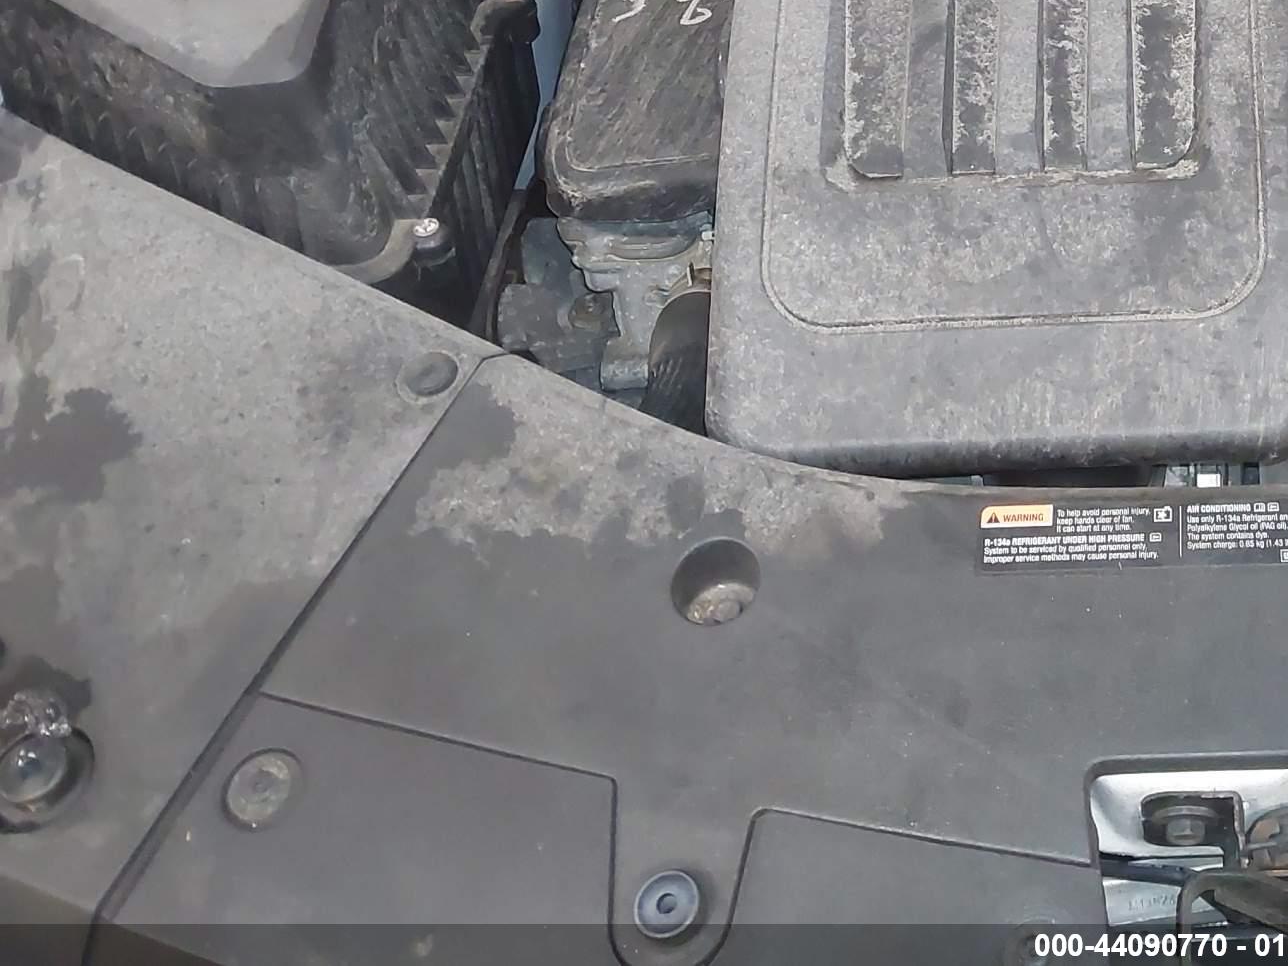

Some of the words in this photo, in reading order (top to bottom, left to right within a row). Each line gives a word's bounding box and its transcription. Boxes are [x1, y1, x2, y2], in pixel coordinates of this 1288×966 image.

[1067, 509, 1079, 518] help
[1081, 508, 1099, 516] avoid
[1102, 508, 1129, 517] personal
[1201, 504, 1251, 513] CONDITIONING
[1003, 514, 1044, 522] WARNING
[1057, 517, 1072, 526] keep
[1075, 516, 1094, 524] hands
[1122, 515, 1134, 523] fan.
[1201, 516, 1214, 524] only
[1242, 514, 1278, 523] Refrigerant
[1188, 524, 1227, 532] Polyalkylene
[1260, 523, 1275, 531] (PAG
[985, 538, 1010, 546] R-134a
[1012, 536, 1061, 545] REFRIGERANT
[1063, 536, 1087, 544] UNDER
[1089, 535, 1106, 543] HIGH
[1108, 534, 1144, 542] PRESSURE
[1201, 533, 1224, 541] system
[984, 547, 1009, 556] System
[1029, 545, 1057, 553] serviced
[1069, 544, 1096, 554] qualified
[1099, 543, 1130, 553] personnel
[1187, 542, 1211, 550] System
[1213, 541, 1238, 549] charge:
[1266, 540, 1283, 548] (1.43
[984, 555, 1014, 564] Improper
[1016, 554, 1039, 562] service
[1041, 553, 1070, 561] methods
[1072, 554, 1086, 562] may
[1109, 551, 1137, 561] personal
[1139, 551, 1158, 560] injury.
